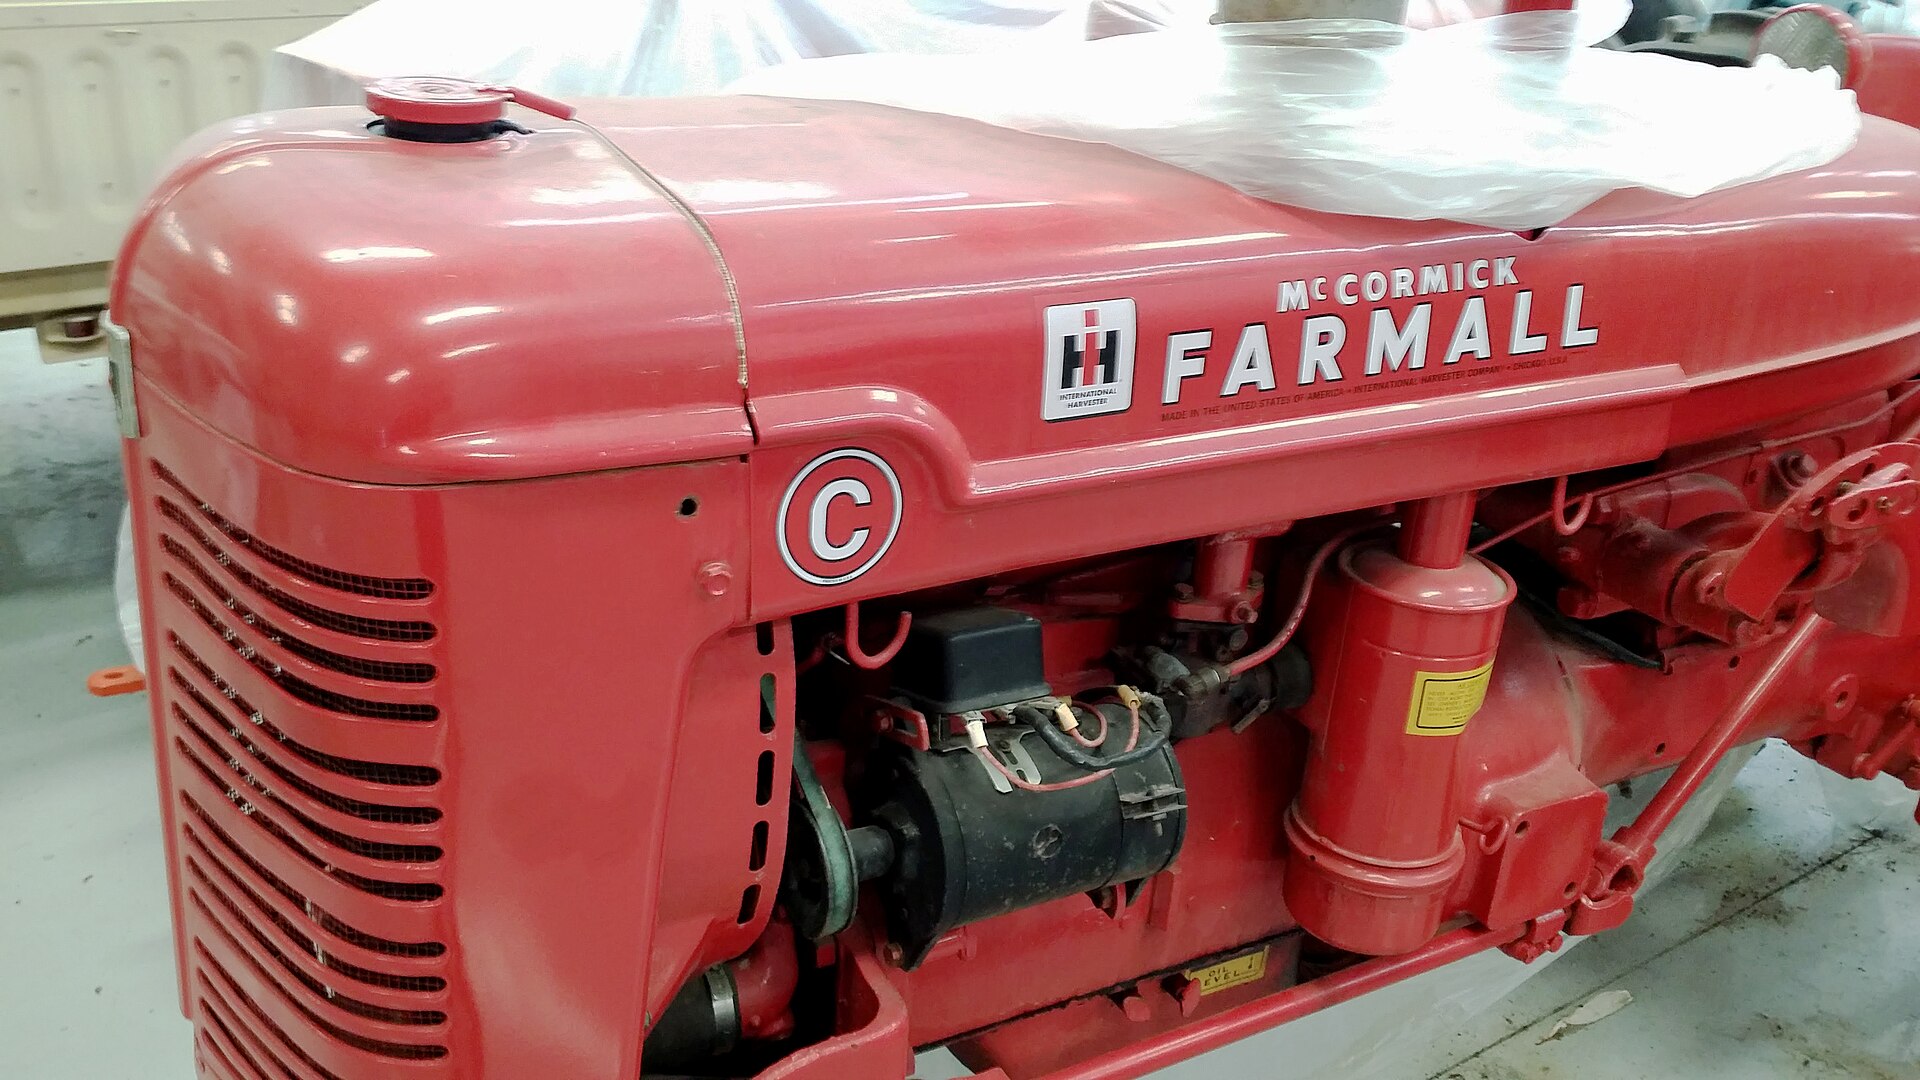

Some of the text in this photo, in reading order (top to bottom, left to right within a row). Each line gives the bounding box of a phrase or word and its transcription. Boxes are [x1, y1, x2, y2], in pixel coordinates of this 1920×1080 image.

[1162, 284, 1600, 405] FARMALL
[1060, 388, 1117, 401] INTERNATIONAL
[1161, 411, 1187, 422] MADE
[1190, 410, 1199, 418] IN
[1203, 406, 1219, 416] THE
[1223, 401, 1257, 413] UNITED
[1259, 397, 1291, 408] STATES
[1294, 394, 1304, 403] OF
[1307, 388, 1344, 400] AMERICA
[1354, 379, 1417, 393] INTERNATIONAL
[1421, 371, 1465, 383] HARVESTER
[1467, 366, 1501, 377] COMPANY
[1512, 359, 1547, 371] CHICAGO
[1067, 398, 1108, 409] HARVESTER
[809, 477, 872, 562] C
[1204, 971, 1240, 987] EVEL
[1209, 967, 1228, 978] OIL
